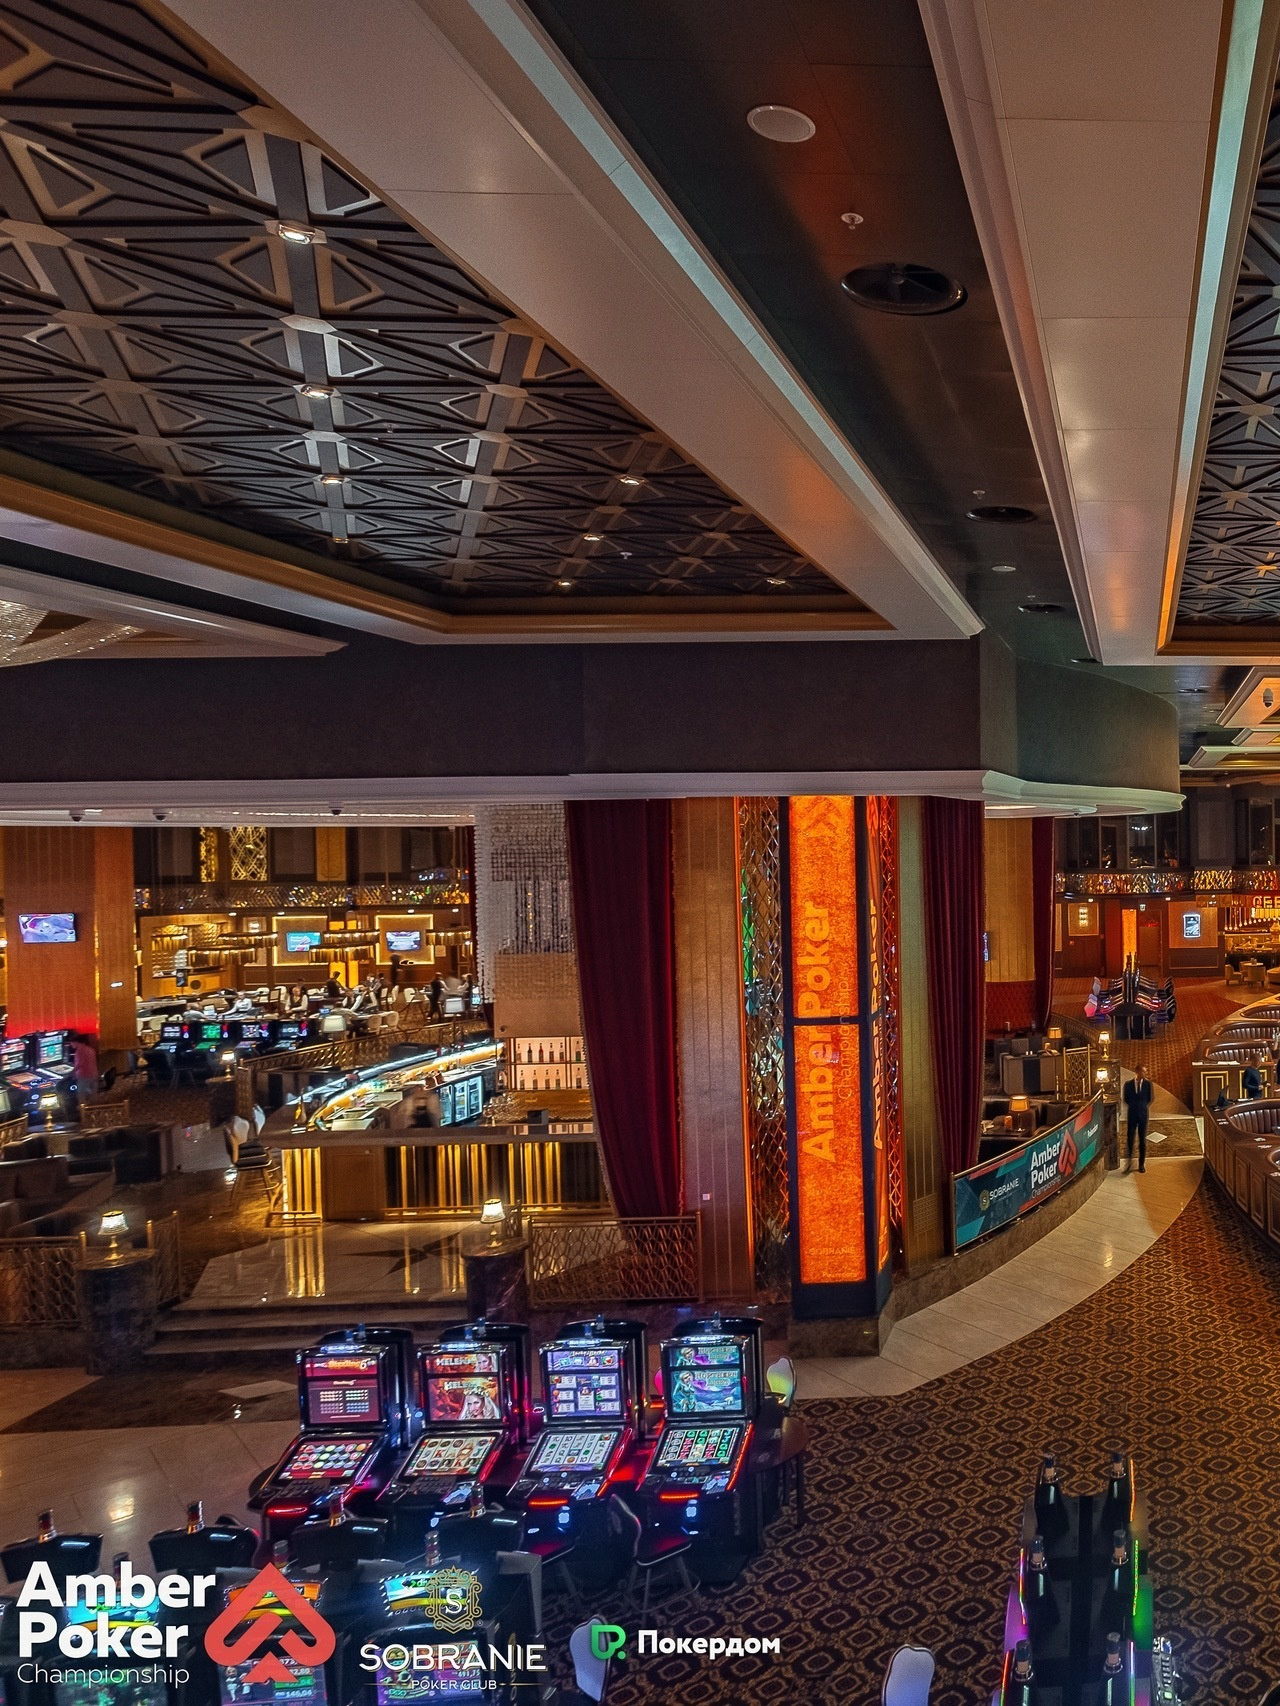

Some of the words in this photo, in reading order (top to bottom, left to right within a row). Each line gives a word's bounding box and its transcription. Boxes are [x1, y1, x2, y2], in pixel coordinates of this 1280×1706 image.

[797, 900, 831, 1018] Poker
[801, 1025, 836, 1162] Amber
[1030, 1141, 1061, 1170] Amber
[1030, 1161, 1058, 1188] Poker
[989, 1178, 1020, 1201] SOBRANIE
